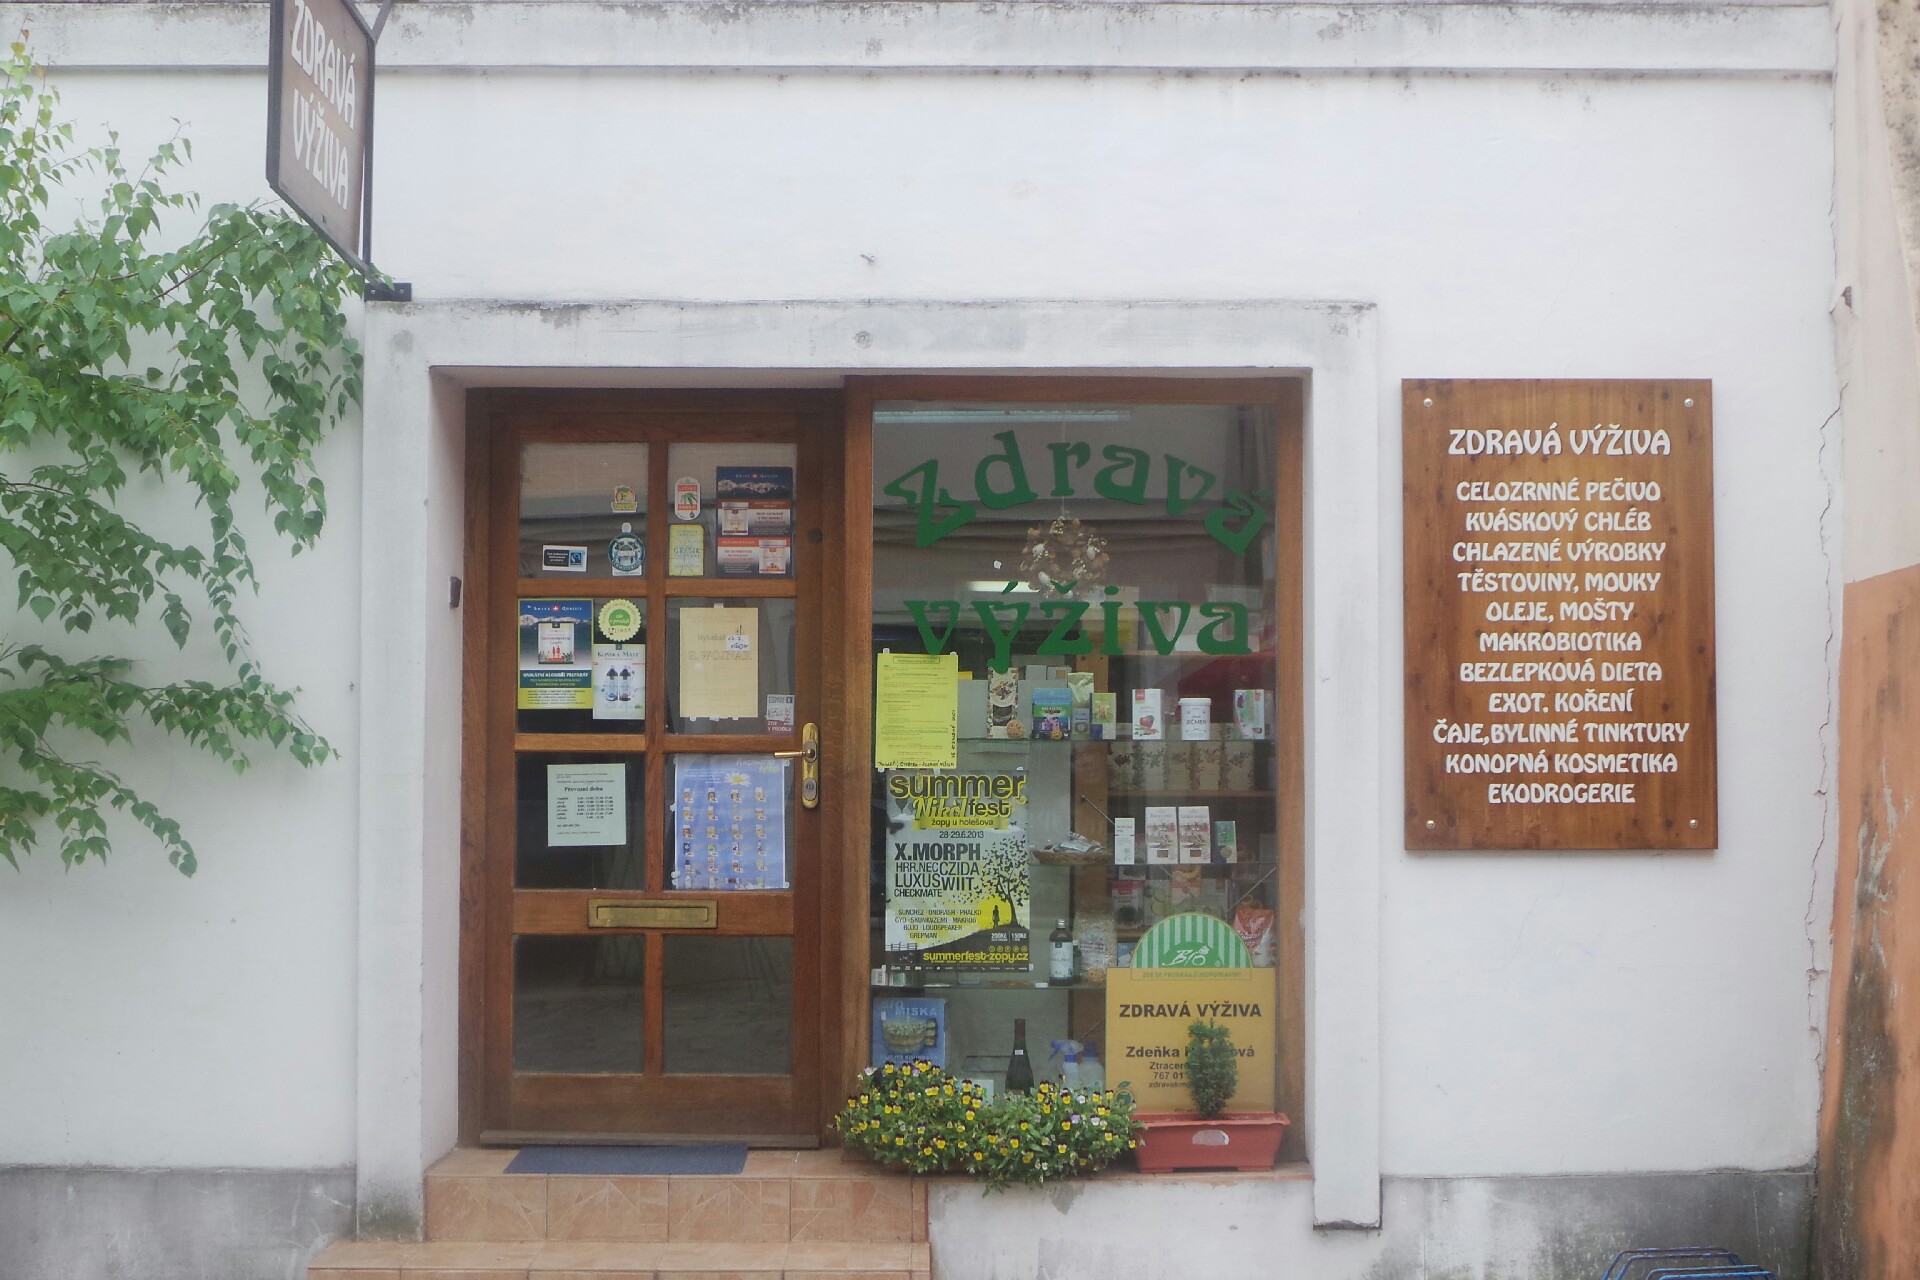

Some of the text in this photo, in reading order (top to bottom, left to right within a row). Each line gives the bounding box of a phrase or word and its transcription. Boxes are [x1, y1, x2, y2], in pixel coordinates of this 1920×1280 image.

[291, 0, 356, 130] ZDRAVÁ
[293, 88, 348, 210] VÝŽIVA
[1448, 422, 1670, 455] ZDRAVÁ VÝŽIVA
[1456, 477, 1660, 501] CELOZRNNÉ PEČIVO
[1466, 508, 1651, 532] KVÁSKOVÝ CHLÉB
[1453, 538, 1666, 562] CHLAZENÉ VÝROBKY
[1458, 568, 1660, 593] TĚSTOVINY, MOUKY
[1486, 598, 1634, 623] OLEJE, MOŠTY
[904, 580, 1252, 674] výživa
[1480, 632, 1641, 652] MAKROBIOTIKA
[1460, 658, 1662, 682] BEZLEPKOVÁ DIETA
[1489, 689, 1634, 713] EXOT. KOŘENÍ
[1583, 723, 1689, 743] TINKTURY
[1446, 749, 1677, 773] KONOPNÁ KOSMETIKA
[889, 774, 1026, 799] summer
[1488, 783, 1635, 803] EKODROGERIE
[967, 799, 1011, 817] fest
[931, 818, 951, 828] žopy
[960, 818, 994, 826] holešova
[894, 842, 981, 861] X.MORPH
[939, 861, 980, 876] CZIDA
[895, 873, 975, 891] LUXUS WIIT
[894, 888, 942, 897] CHECKMATE
[922, 950, 1029, 963] summerfest-zopy.cz
[894, 1007, 937, 1016] MISKA
[1119, 1001, 1261, 1018] ZDRAVÁ VÝŽIVA
[1125, 1046, 1180, 1058] Zdeňka
[1153, 1072, 1184, 1080] 767 01
